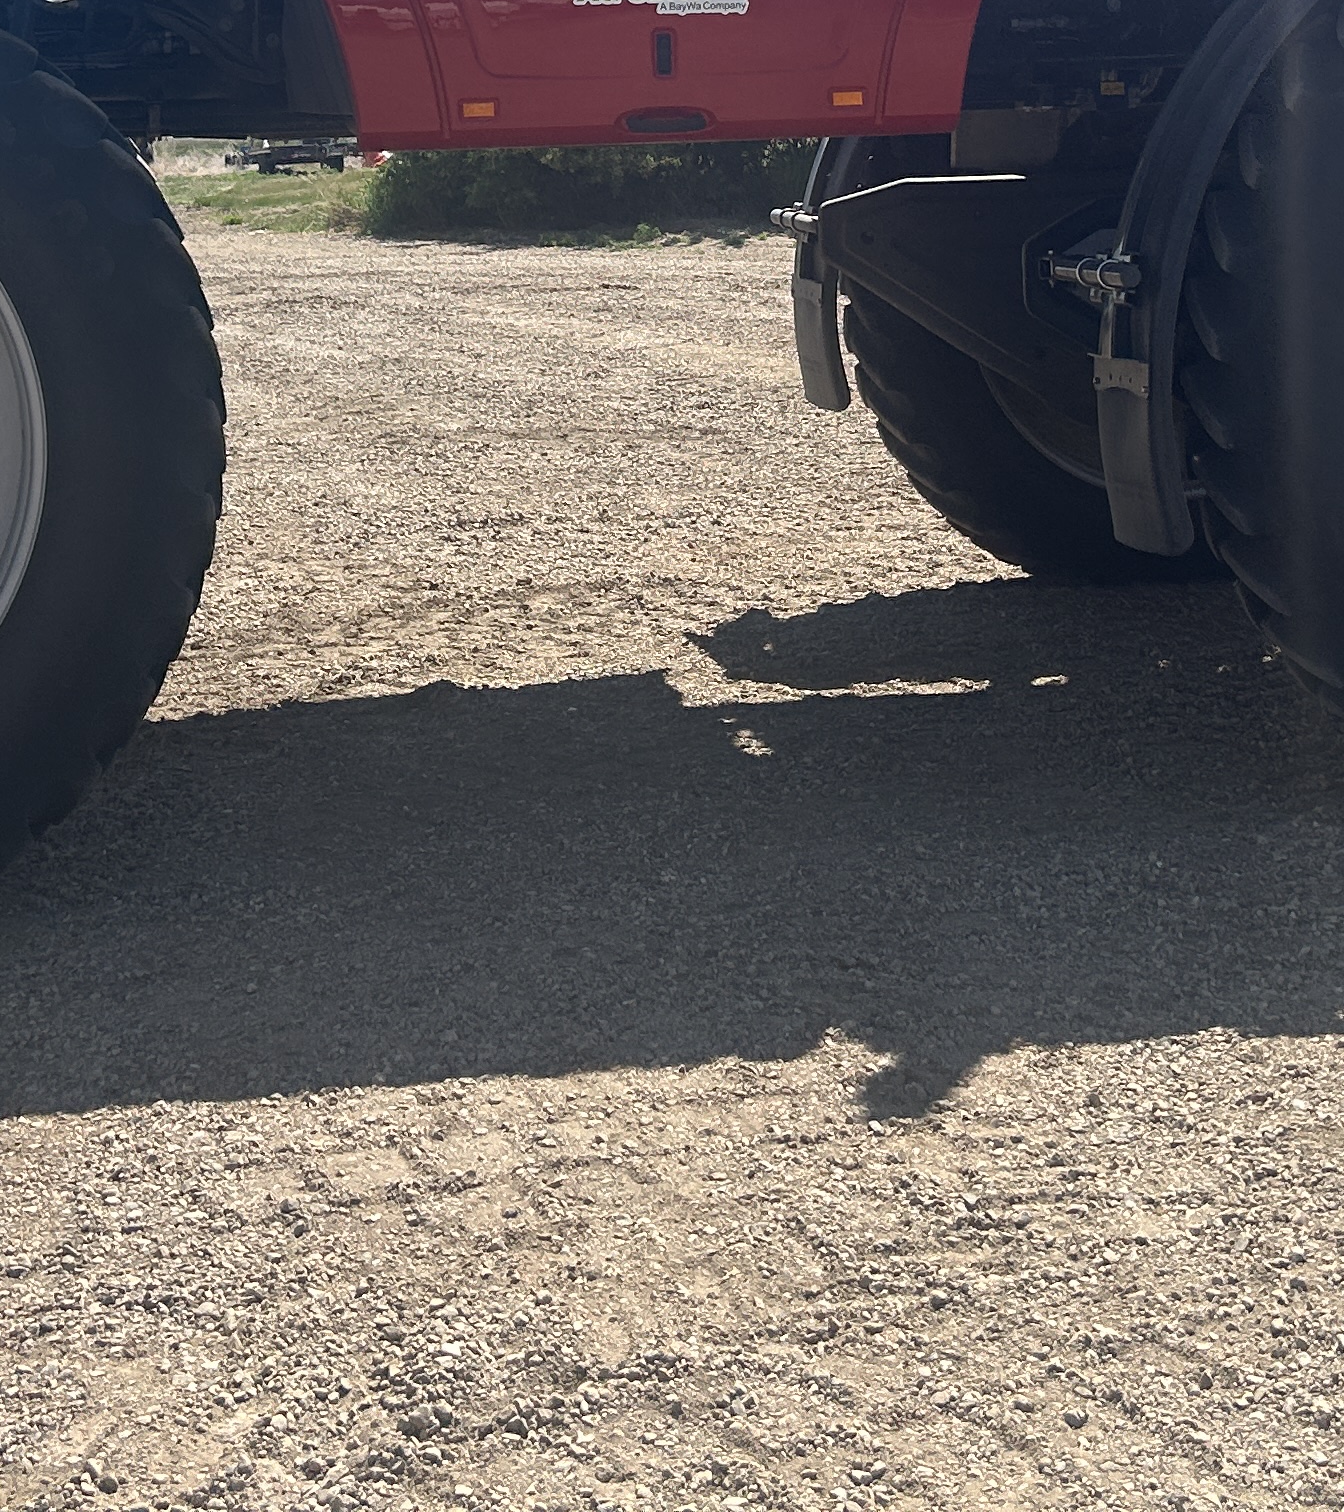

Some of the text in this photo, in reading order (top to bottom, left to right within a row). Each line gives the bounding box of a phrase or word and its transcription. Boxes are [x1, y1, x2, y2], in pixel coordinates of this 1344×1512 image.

[659, 0, 747, 13] A BayWa Company
